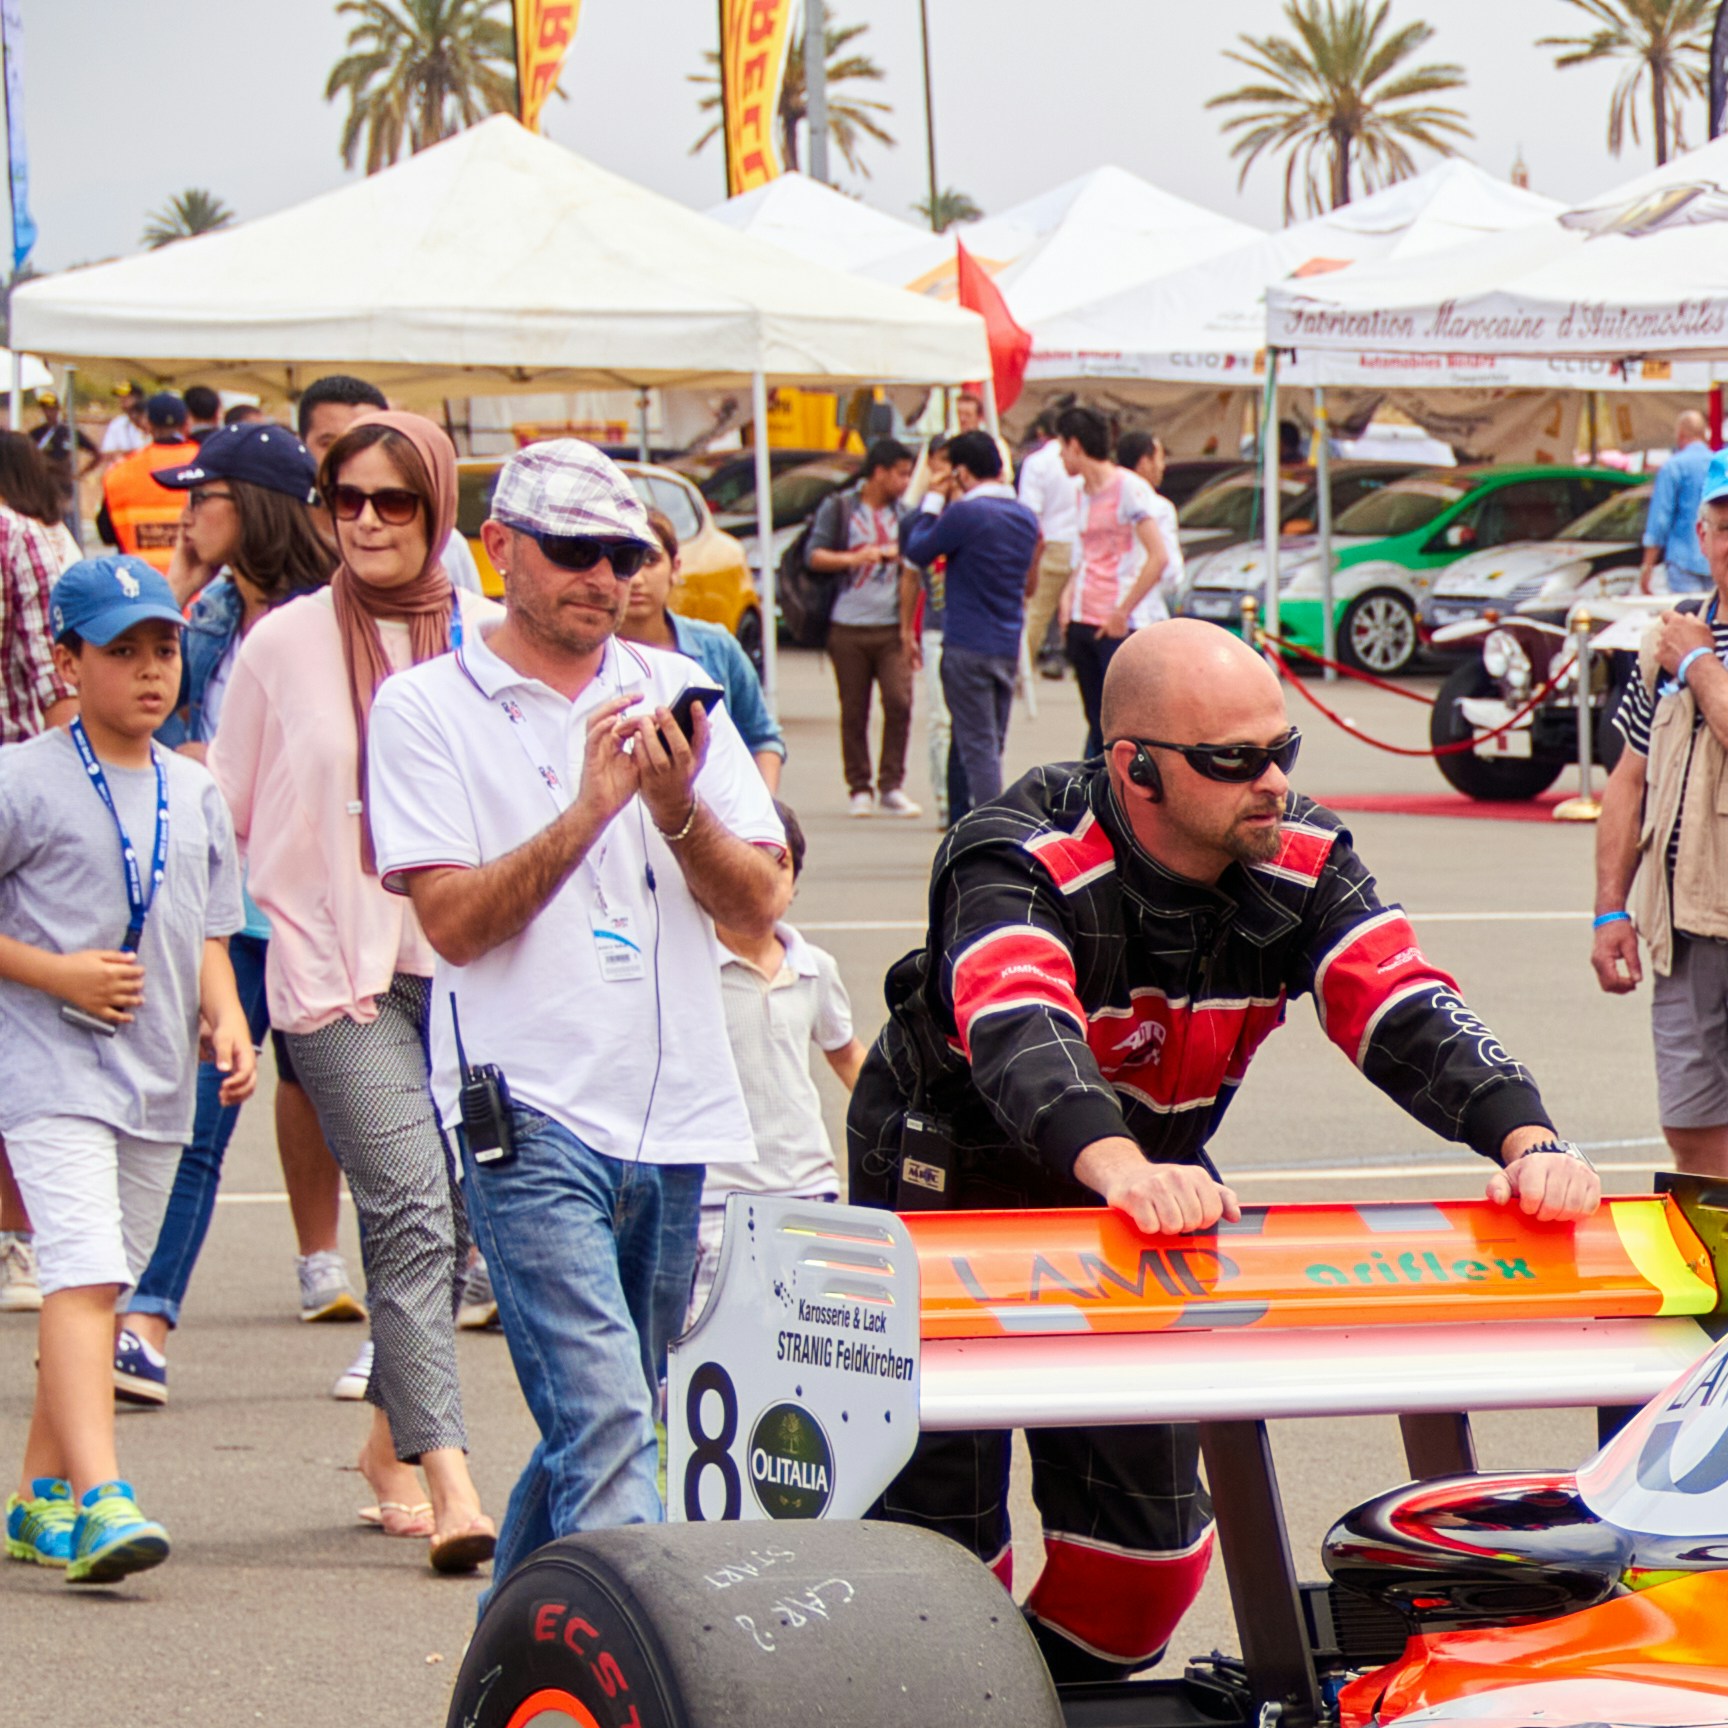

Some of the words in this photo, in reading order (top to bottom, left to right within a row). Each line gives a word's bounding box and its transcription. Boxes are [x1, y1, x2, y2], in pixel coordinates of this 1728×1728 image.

[1284, 309, 1414, 338] Fabrication
[1424, 300, 1544, 341] Marocaine
[1170, 352, 1219, 367] CLIO
[1112, 1021, 1166, 1051] AUTO
[950, 1248, 1241, 1300] LAMP
[799, 1299, 850, 1328] Karosserie
[853, 1307, 860, 1330] &
[863, 1310, 887, 1334] Lack
[777, 1331, 832, 1368] STRANIG
[836, 1341, 914, 1381] Feldkirchen
[684, 1361, 741, 1521] 8
[752, 1448, 829, 1492] OLITALIA
